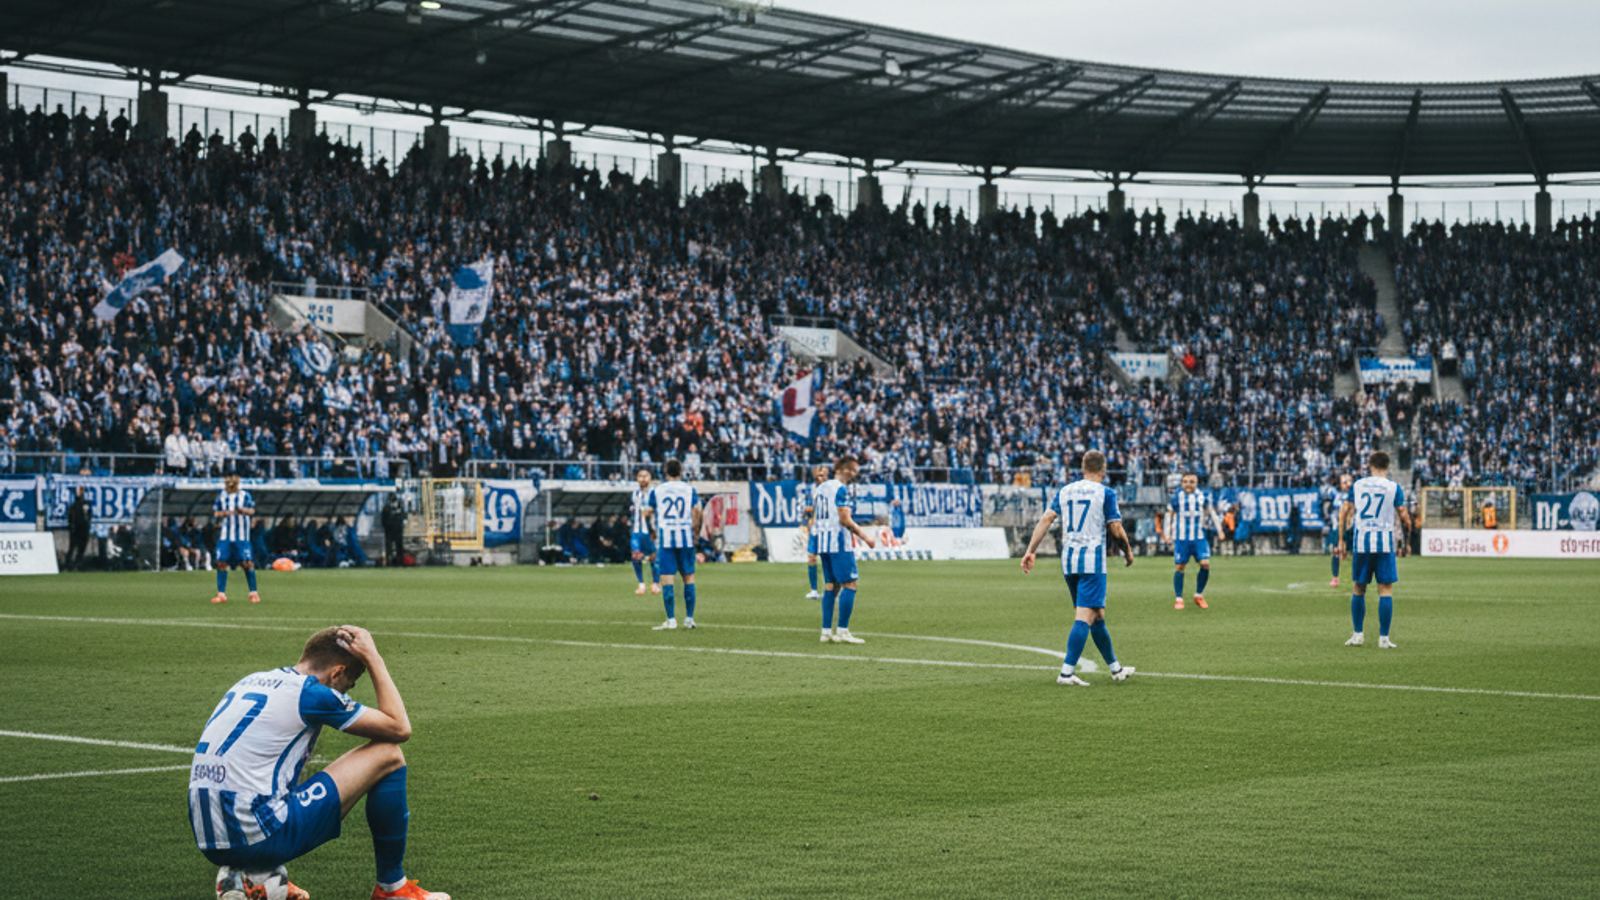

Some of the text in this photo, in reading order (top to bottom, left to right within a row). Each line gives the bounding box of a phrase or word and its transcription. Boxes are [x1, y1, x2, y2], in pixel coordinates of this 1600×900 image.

[1067, 499, 1091, 533] 17
[1360, 492, 1385, 519] 27
[195, 691, 268, 757] 27
